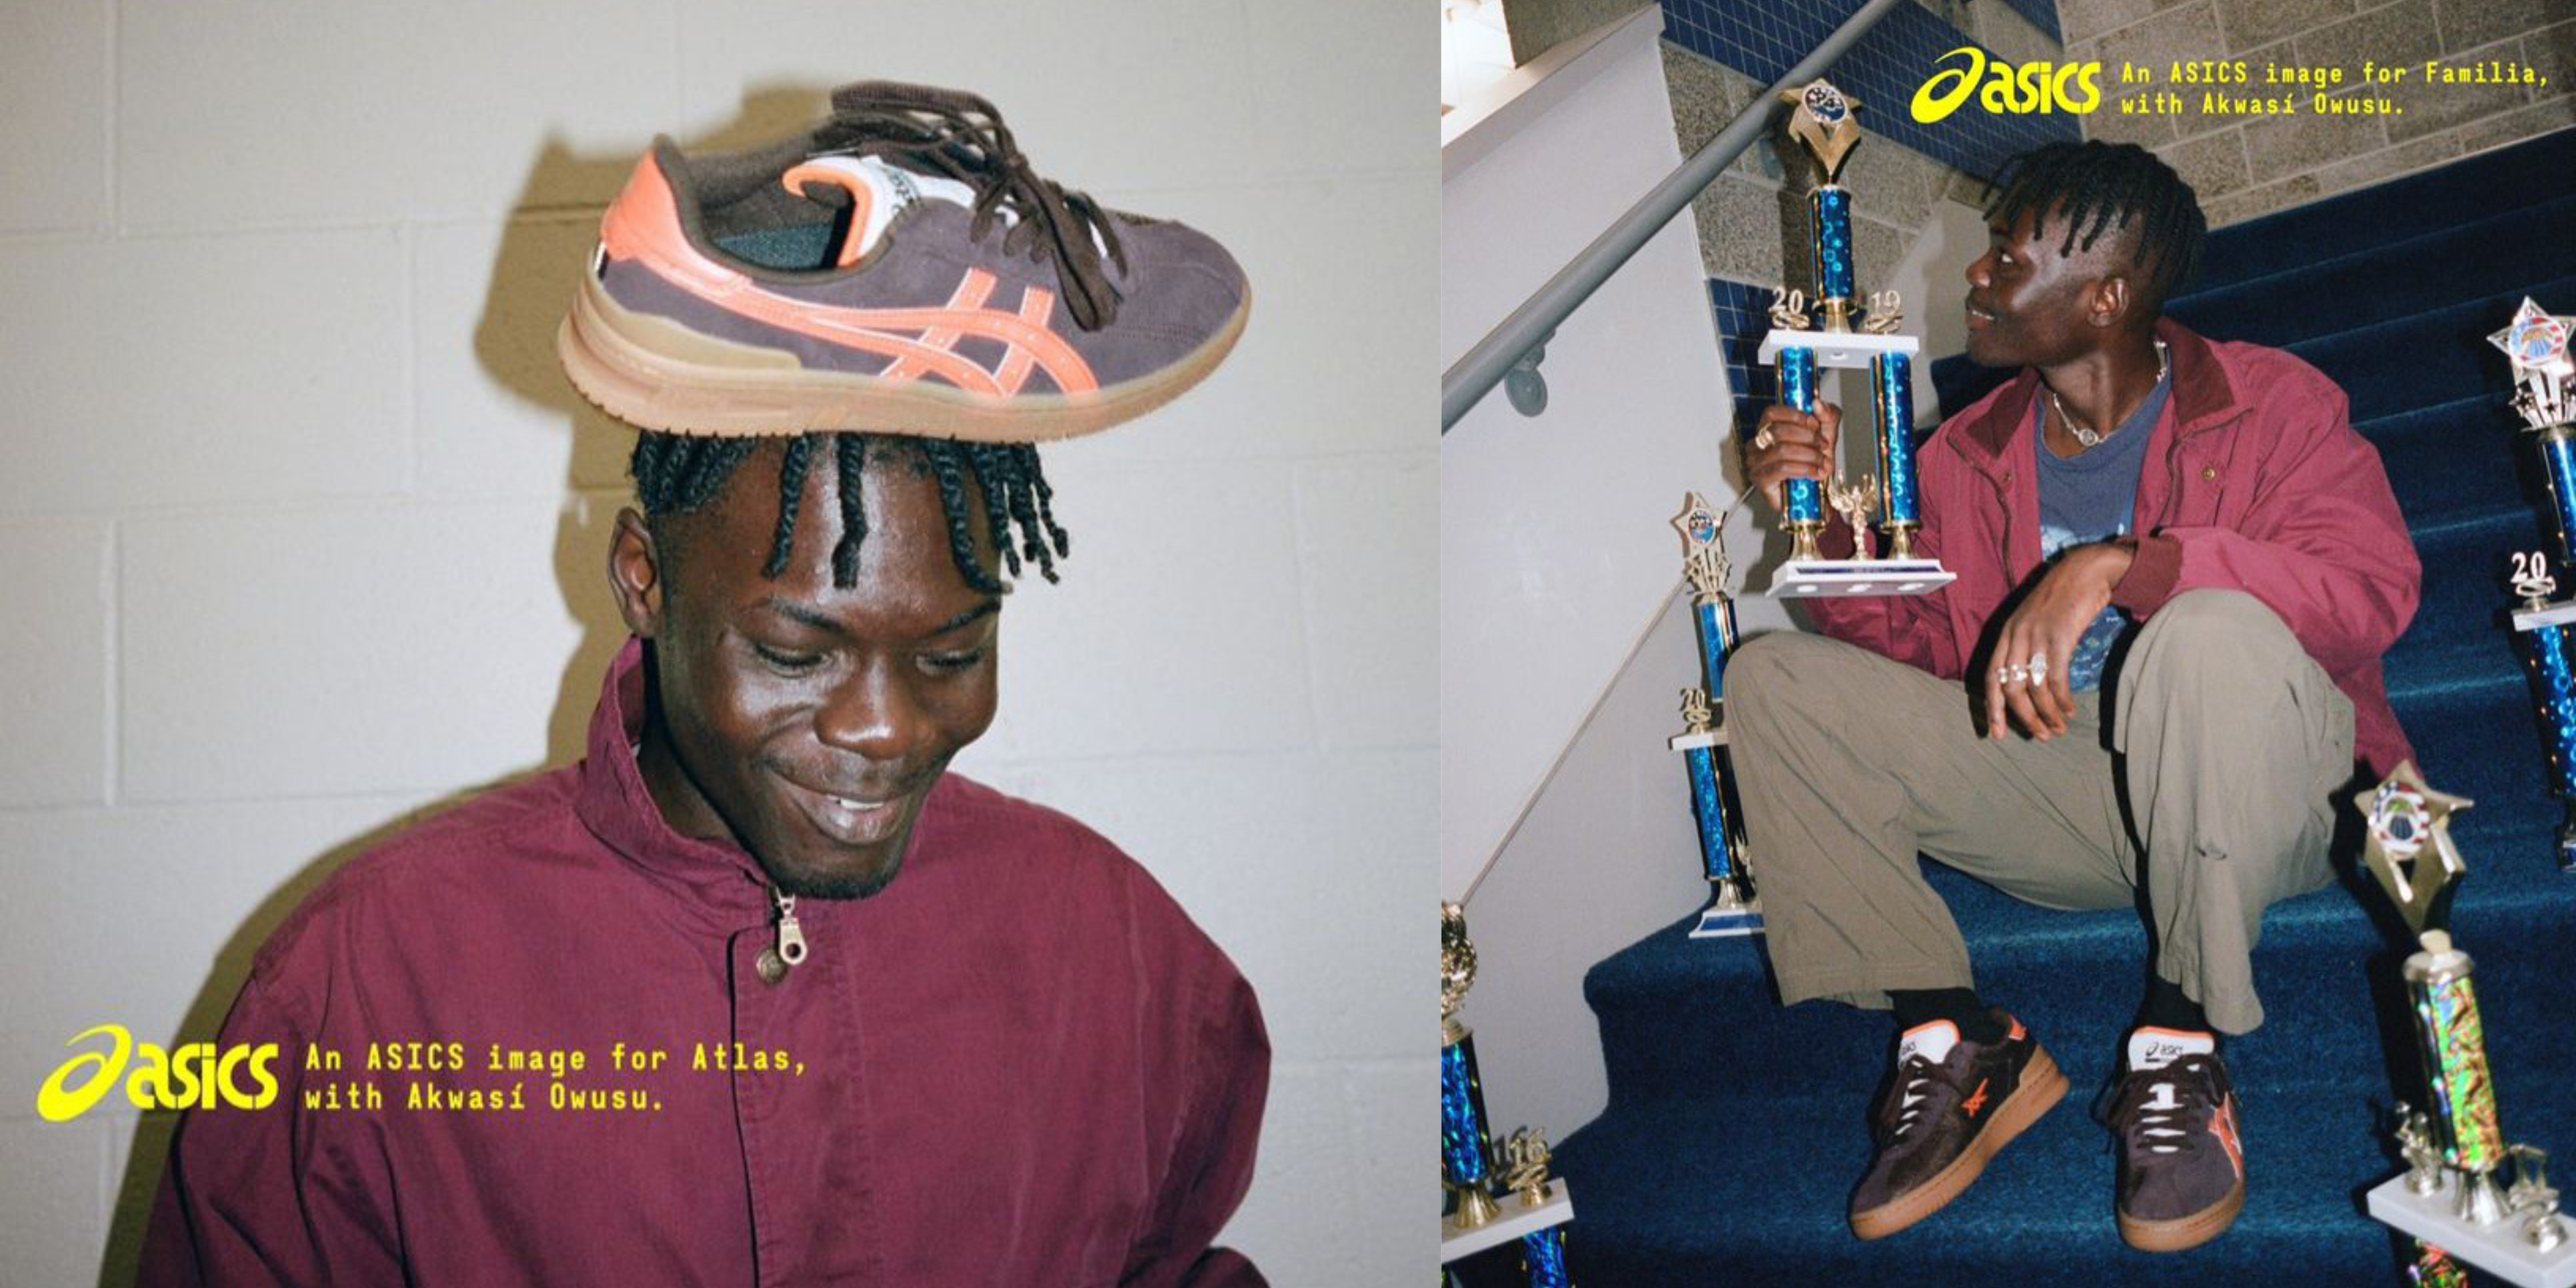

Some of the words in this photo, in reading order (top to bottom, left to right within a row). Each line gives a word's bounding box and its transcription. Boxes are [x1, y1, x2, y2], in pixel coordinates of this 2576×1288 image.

[1768, 285, 1804, 315] 20
[1871, 290, 1901, 317] 19
[2510, 551, 2547, 583] 20
